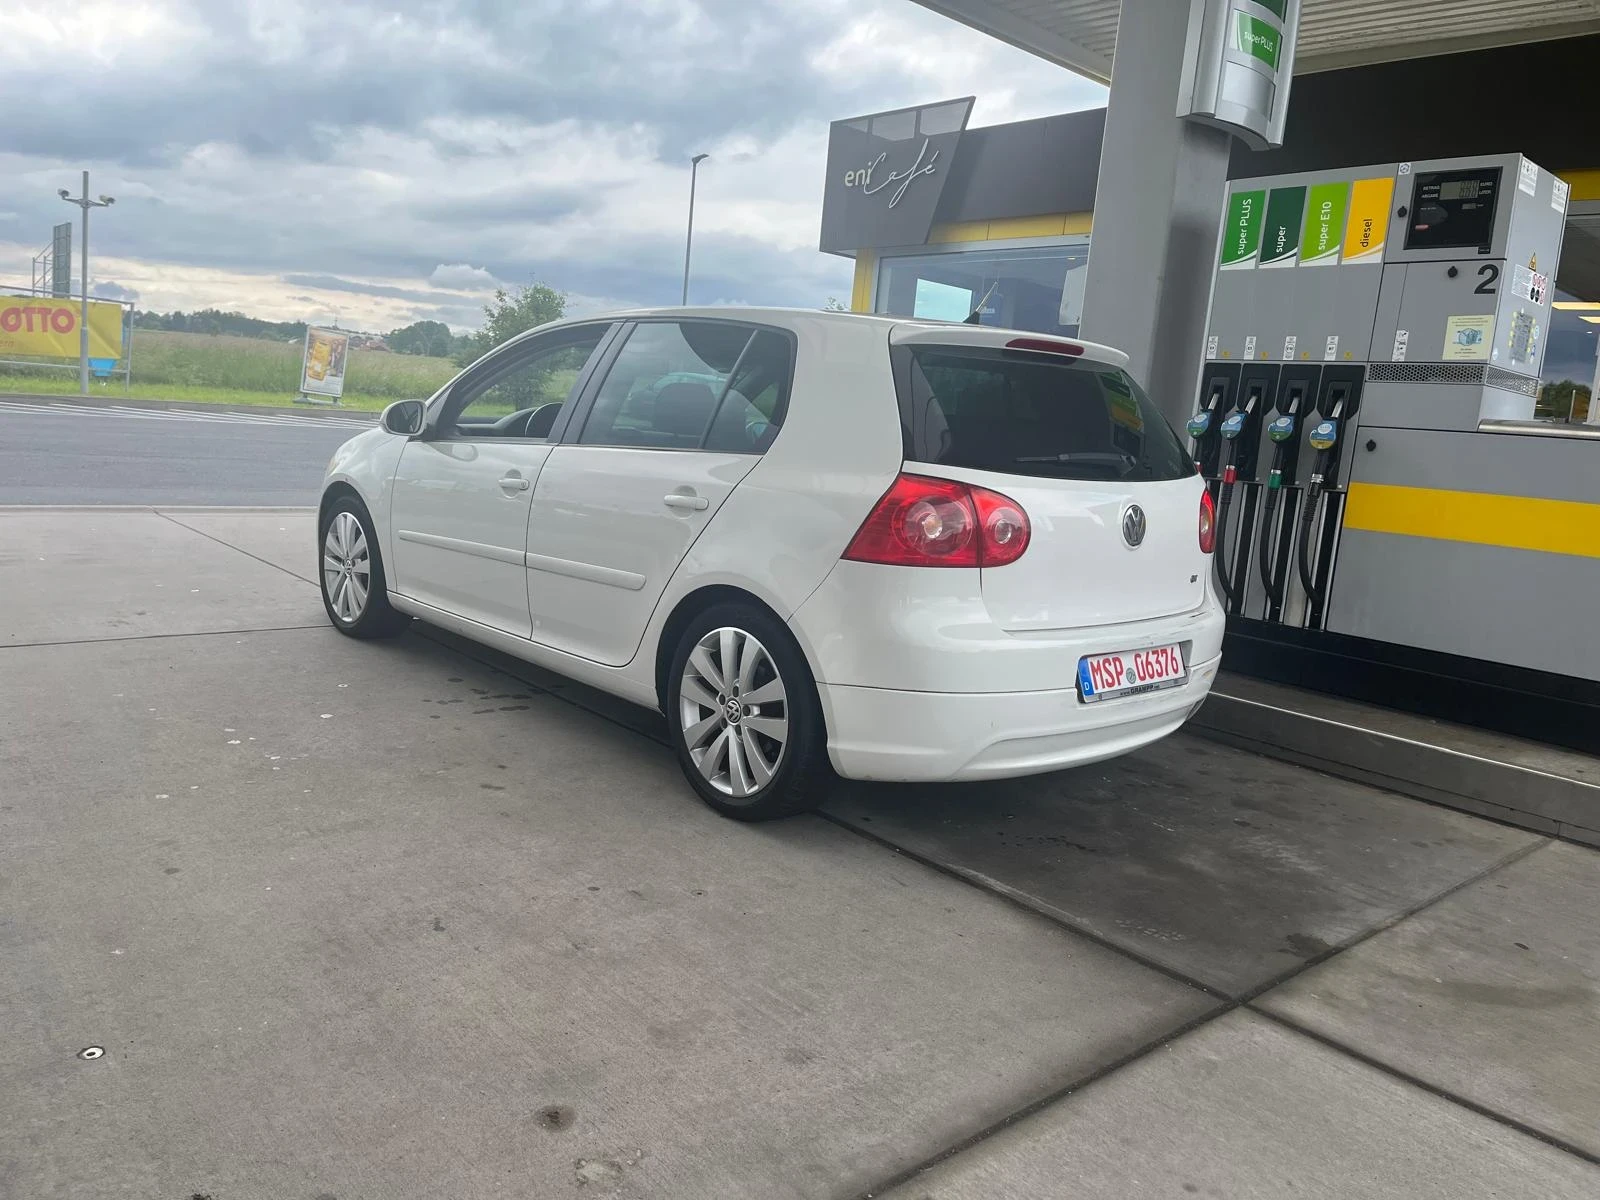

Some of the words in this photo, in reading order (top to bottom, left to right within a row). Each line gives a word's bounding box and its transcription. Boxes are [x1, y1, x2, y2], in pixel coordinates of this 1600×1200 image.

[844, 161, 872, 187] eni
[863, 137, 939, 209] Café
[1239, 198, 1252, 227] PLUS
[1320, 201, 1332, 221] E10
[1237, 228, 1248, 255] super
[1276, 225, 1287, 253] super
[1318, 223, 1329, 251] super
[1359, 218, 1373, 248] diesel
[1473, 263, 1499, 295] 2
[1084, 682, 1090, 691] D
[1089, 656, 1124, 691] MSP
[1134, 646, 1180, 682] 06376
